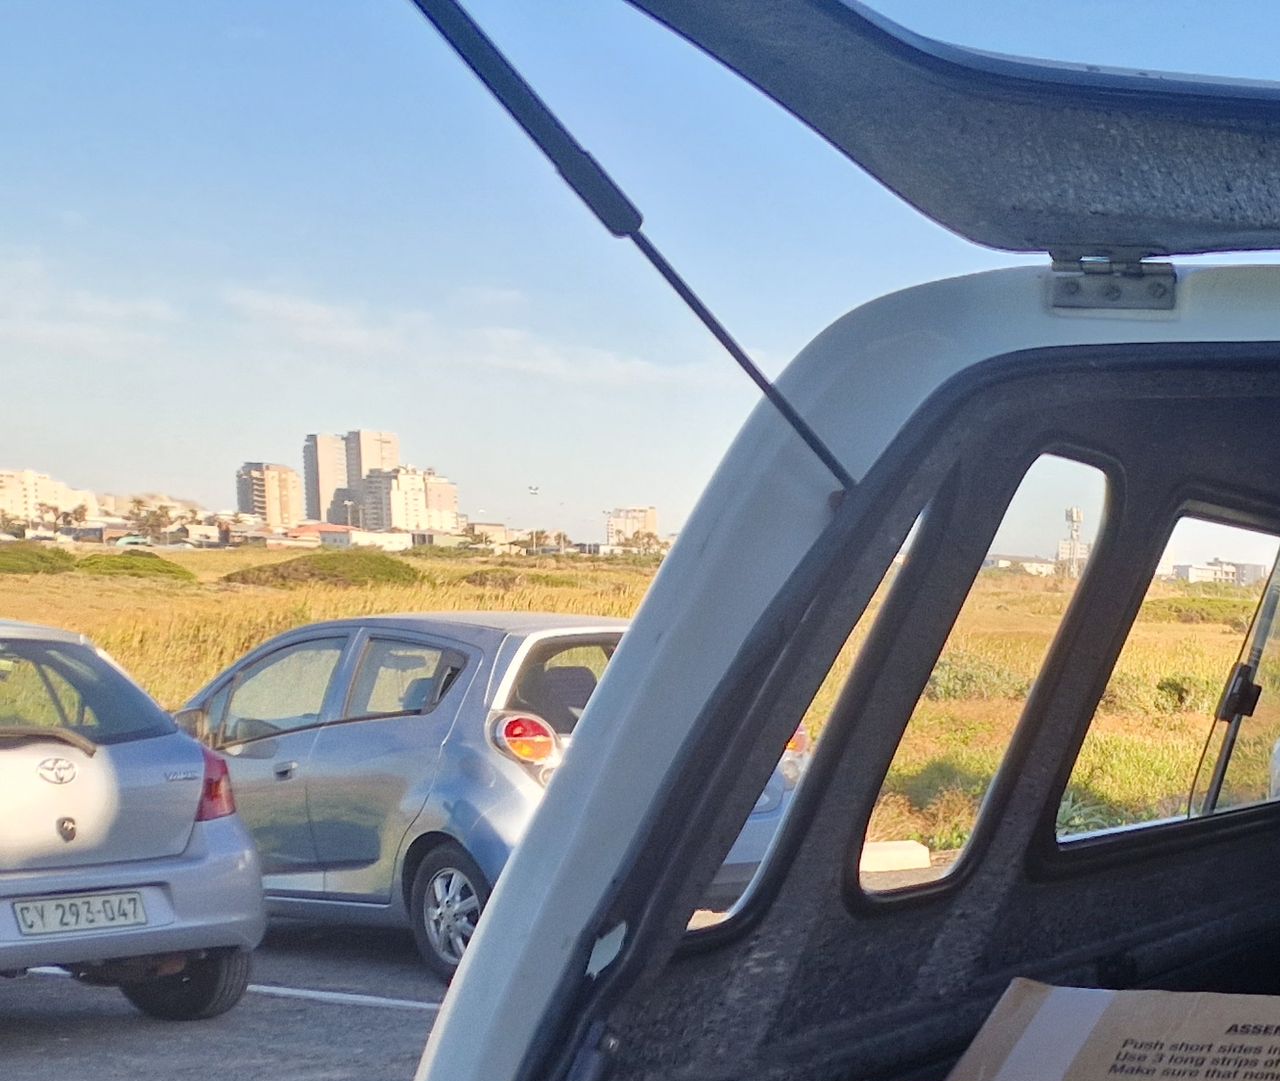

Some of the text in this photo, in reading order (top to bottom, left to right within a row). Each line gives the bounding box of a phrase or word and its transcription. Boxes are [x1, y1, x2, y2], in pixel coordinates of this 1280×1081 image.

[19, 903, 46, 929] CY
[1122, 1038, 1164, 1050] Push
[1169, 1041, 1214, 1052] short
[1218, 1043, 1262, 1055] sides
[1114, 1052, 1147, 1063] Use
[1152, 1053, 1164, 1063] 3
[1168, 1054, 1206, 1067] long
[1210, 1055, 1259, 1068] strips
[1264, 1058, 1280, 1068] of
[1108, 1064, 1156, 1076] Make
[1161, 1068, 1200, 1078] sure
[1204, 1068, 1237, 1080] that
